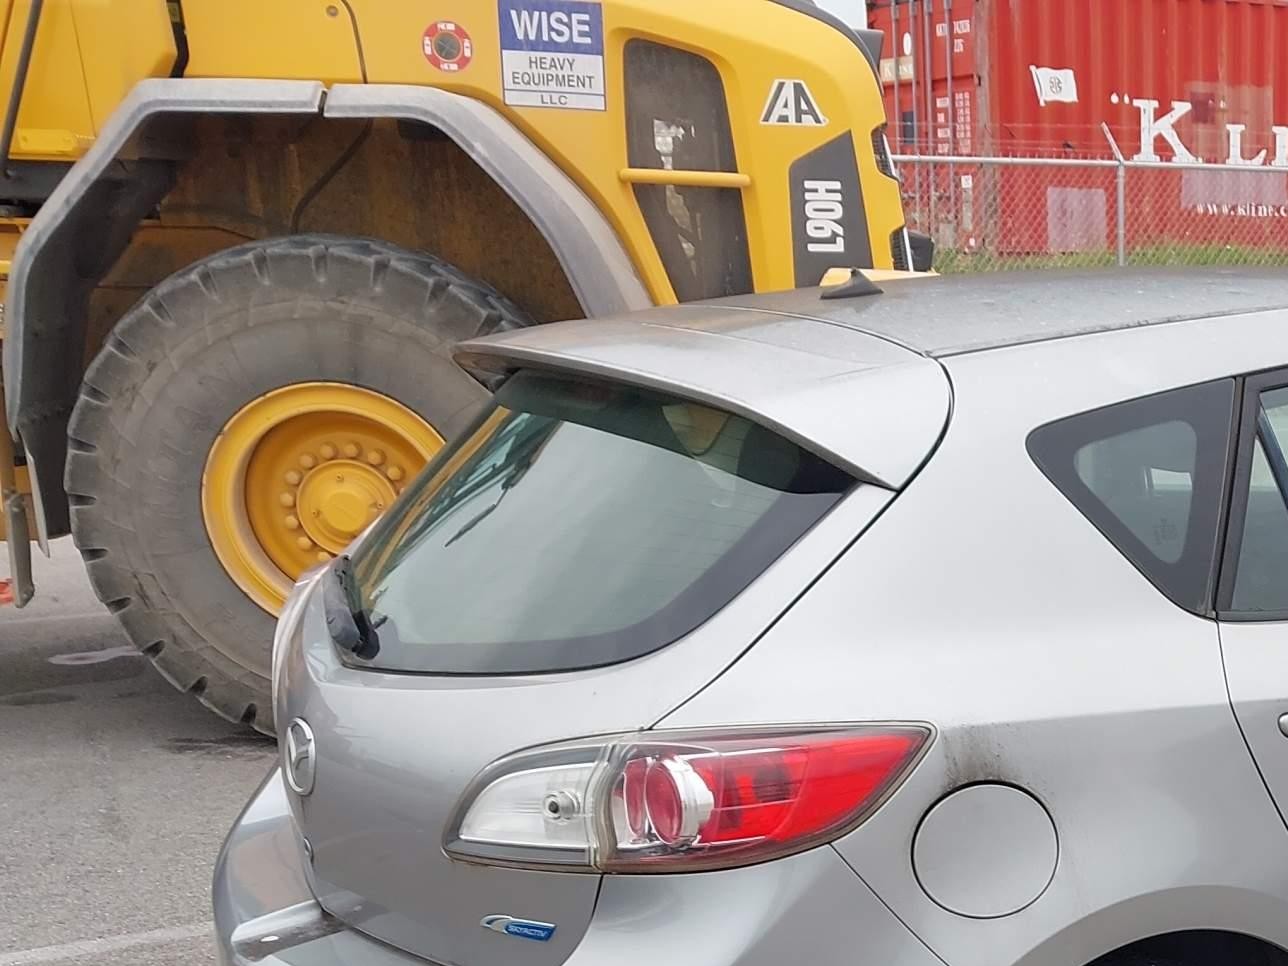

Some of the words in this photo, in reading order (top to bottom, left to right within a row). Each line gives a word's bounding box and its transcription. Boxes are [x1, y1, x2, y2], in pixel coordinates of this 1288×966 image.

[510, 9, 592, 44] WISE
[528, 56, 576, 71] HEAVY
[511, 71, 595, 89] EQUIPMENT
[540, 94, 568, 105] LLC
[803, 180, 845, 252] L90H
